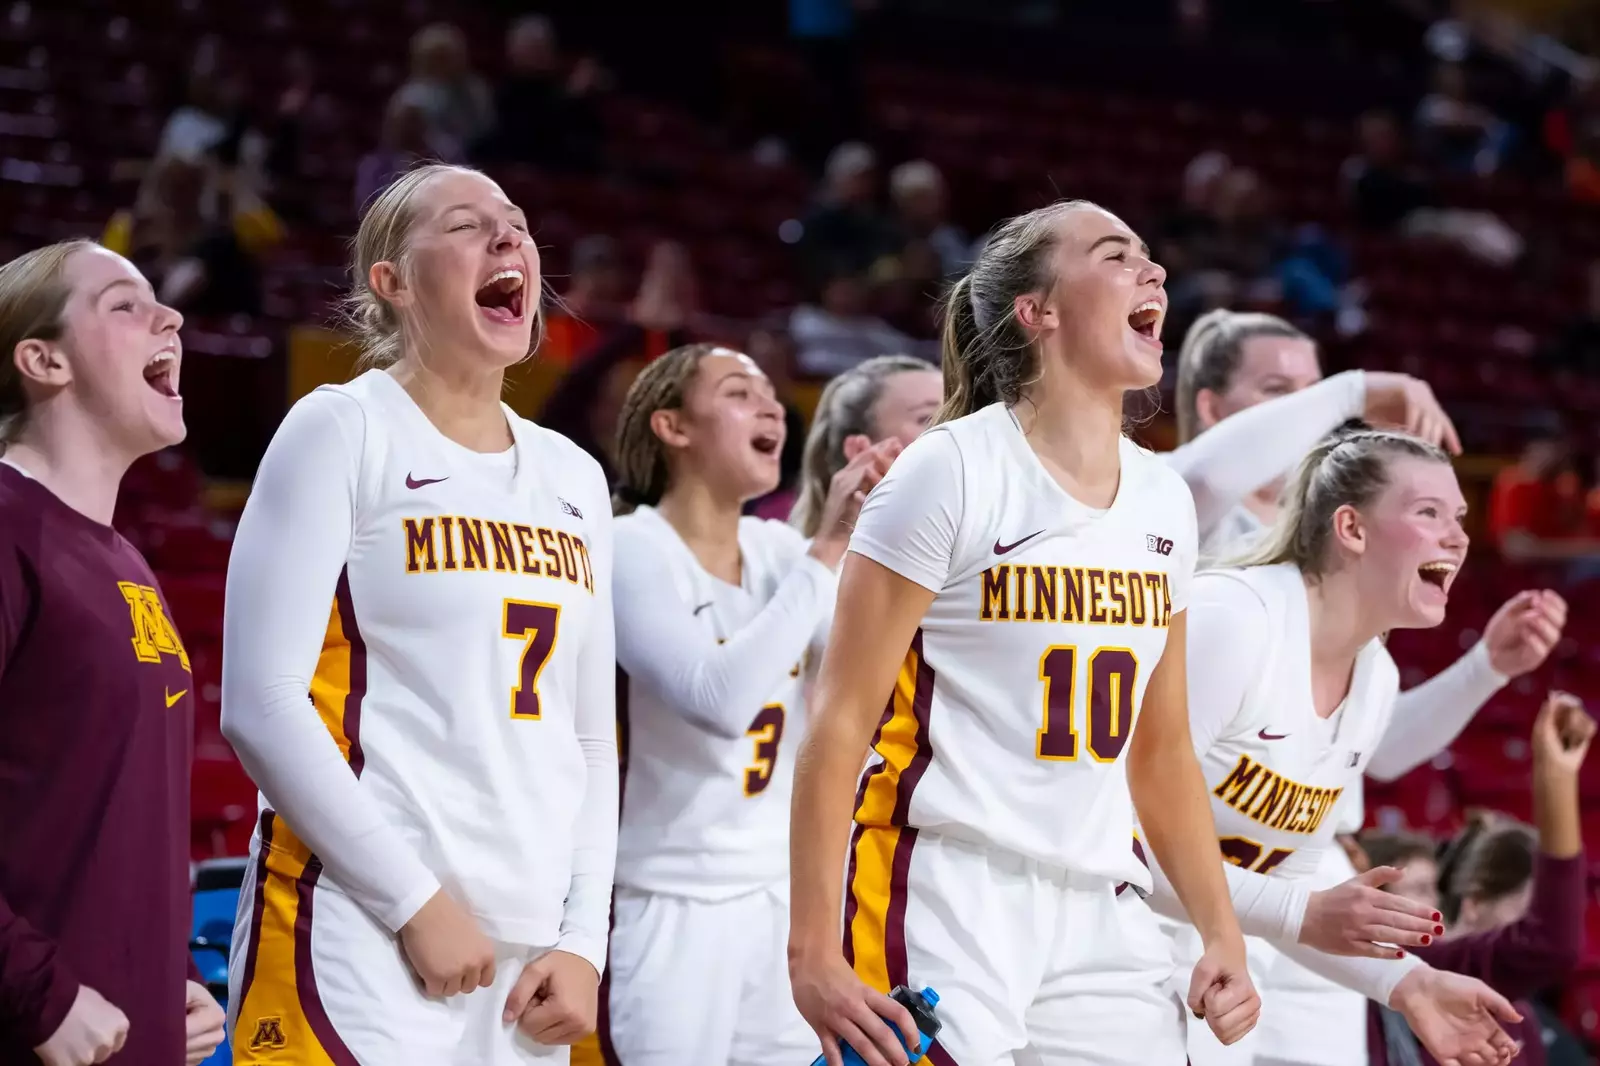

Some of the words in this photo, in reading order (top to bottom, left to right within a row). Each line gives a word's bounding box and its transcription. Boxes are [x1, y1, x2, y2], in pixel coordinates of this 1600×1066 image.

[403, 516, 594, 596] MINNESOT
[1145, 533, 1174, 557] BIG
[117, 580, 192, 674] M
[502, 597, 562, 721] 7
[742, 702, 786, 799] 3
[1035, 644, 1139, 763] 10
[249, 1015, 288, 1051] M
